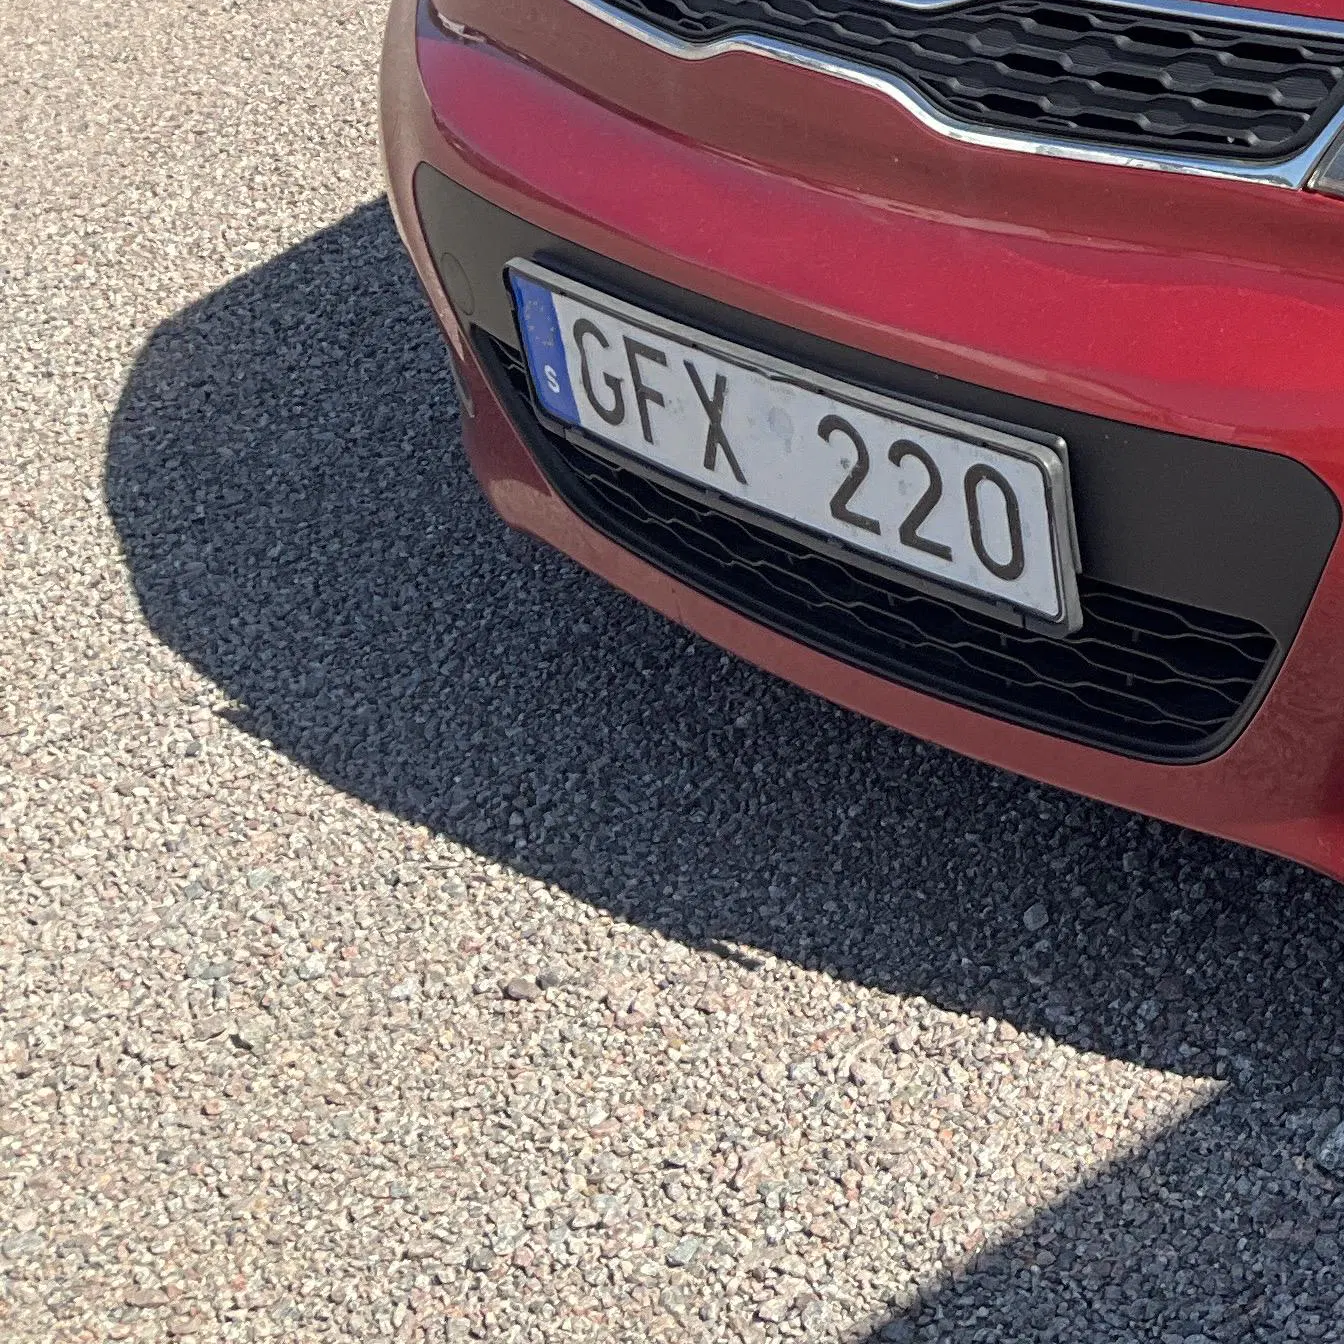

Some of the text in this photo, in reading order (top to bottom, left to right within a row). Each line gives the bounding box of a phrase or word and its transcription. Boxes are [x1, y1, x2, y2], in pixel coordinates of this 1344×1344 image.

[545, 364, 560, 394] S
[573, 318, 1025, 581] GFX 220
